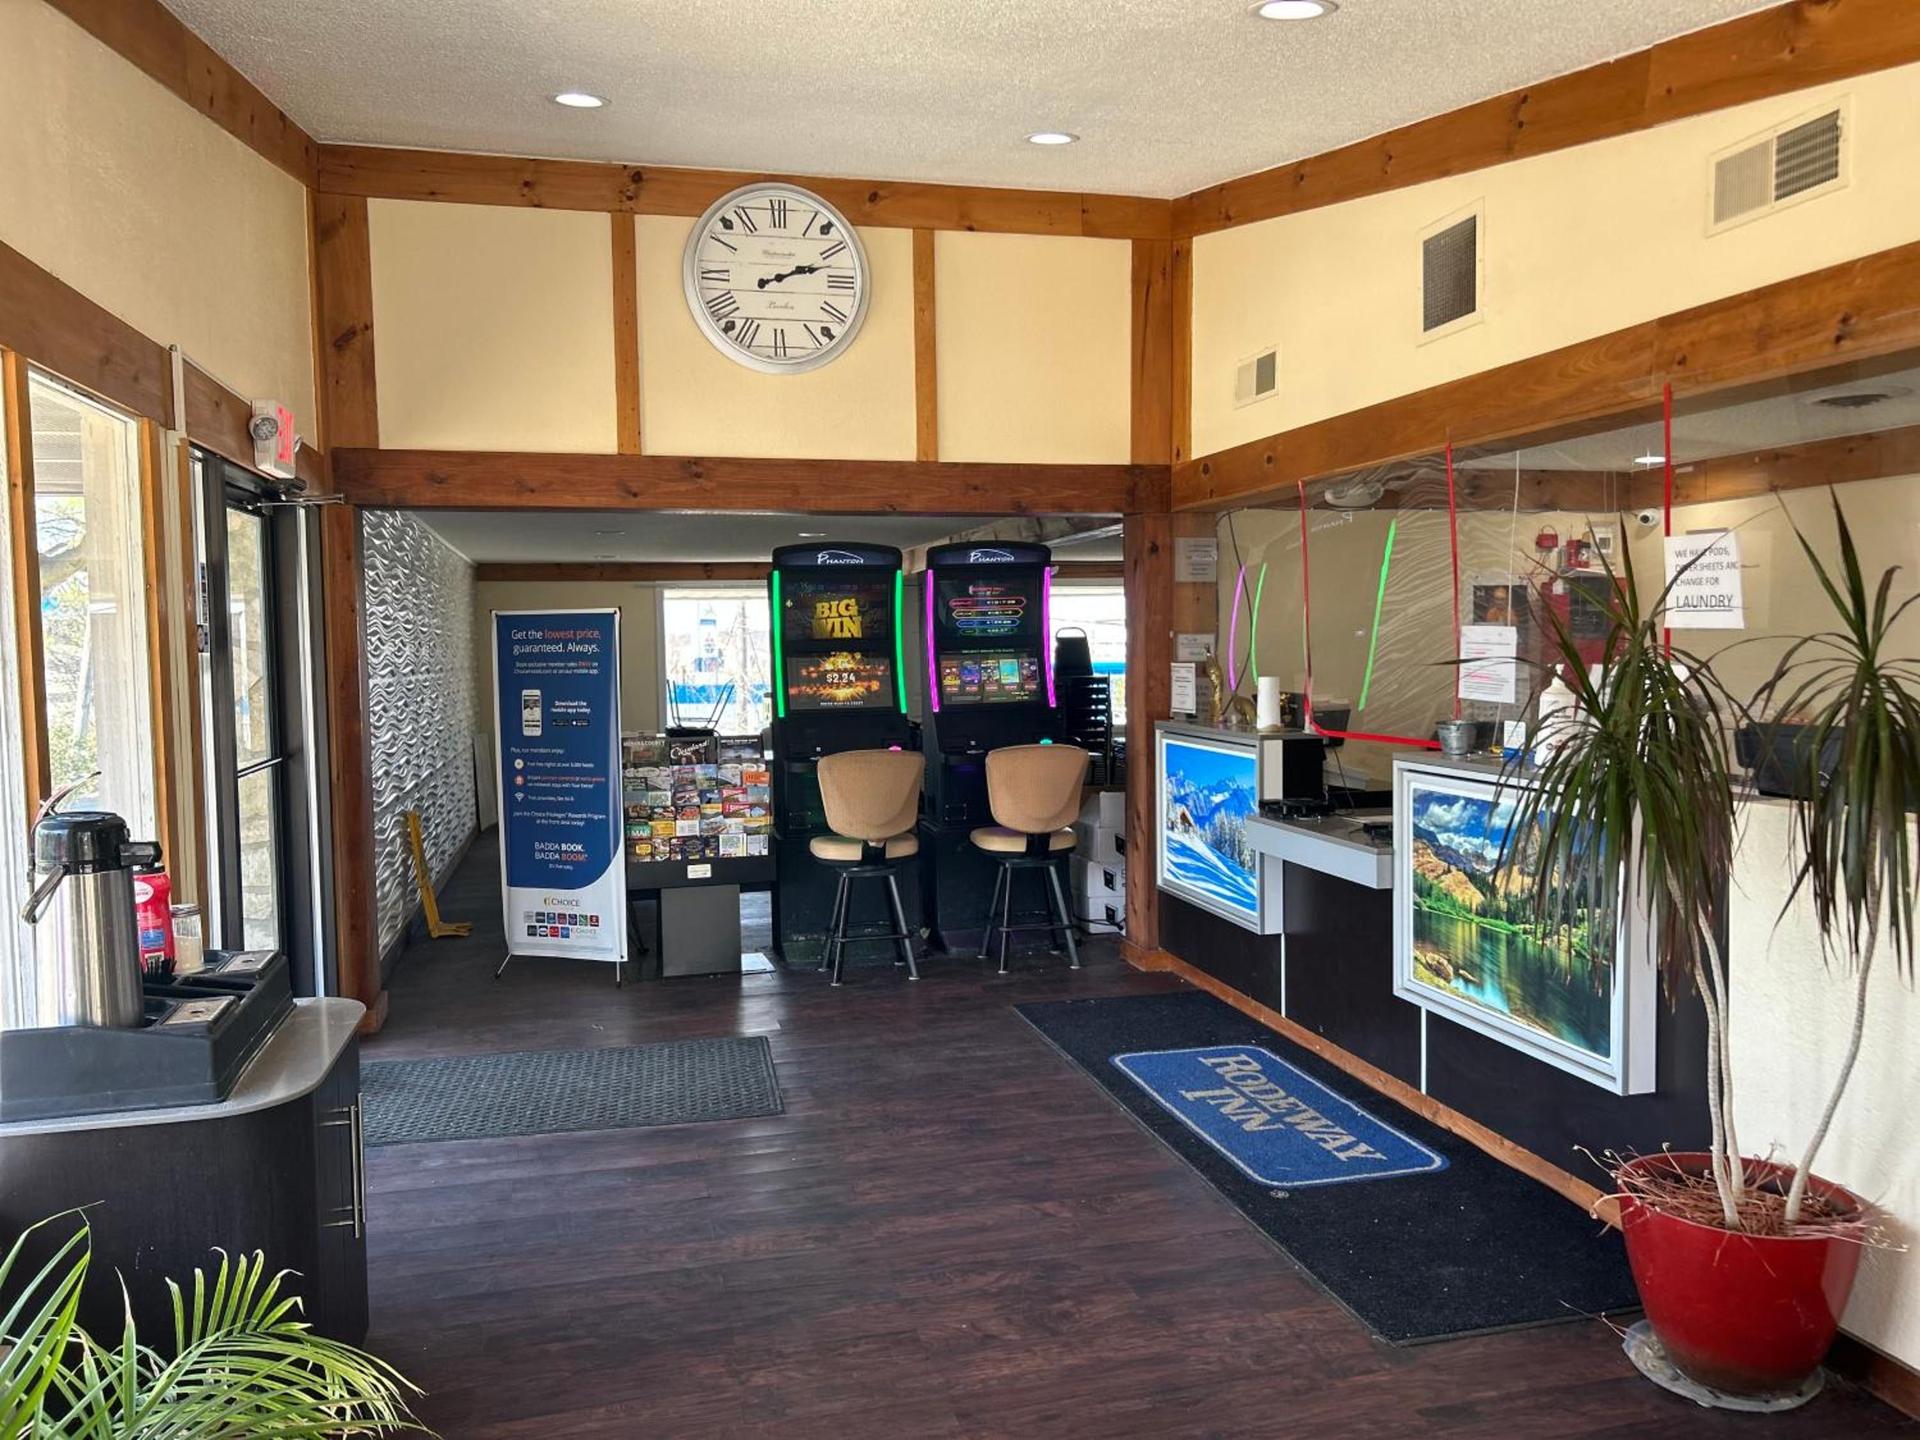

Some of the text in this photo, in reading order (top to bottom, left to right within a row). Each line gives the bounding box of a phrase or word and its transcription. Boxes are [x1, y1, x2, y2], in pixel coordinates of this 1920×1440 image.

[1674, 549, 1688, 558] WE
[1689, 548, 1707, 557] HA
[1675, 562, 1700, 573] DER
[1701, 561, 1725, 572] SHEETS
[1675, 576, 1720, 587] CHANGE FOR
[1676, 594, 1734, 609] LAUNDRY
[815, 598, 859, 619] BIG
[814, 616, 863, 639] WIN
[511, 629, 527, 640] Get
[527, 629, 543, 640] the
[544, 629, 574, 639] lowest
[534, 842, 560, 850] BADDA
[534, 851, 560, 860] BADDA
[1178, 1086, 1286, 1132] INN
[1197, 1053, 1388, 1162] RODEWAY
